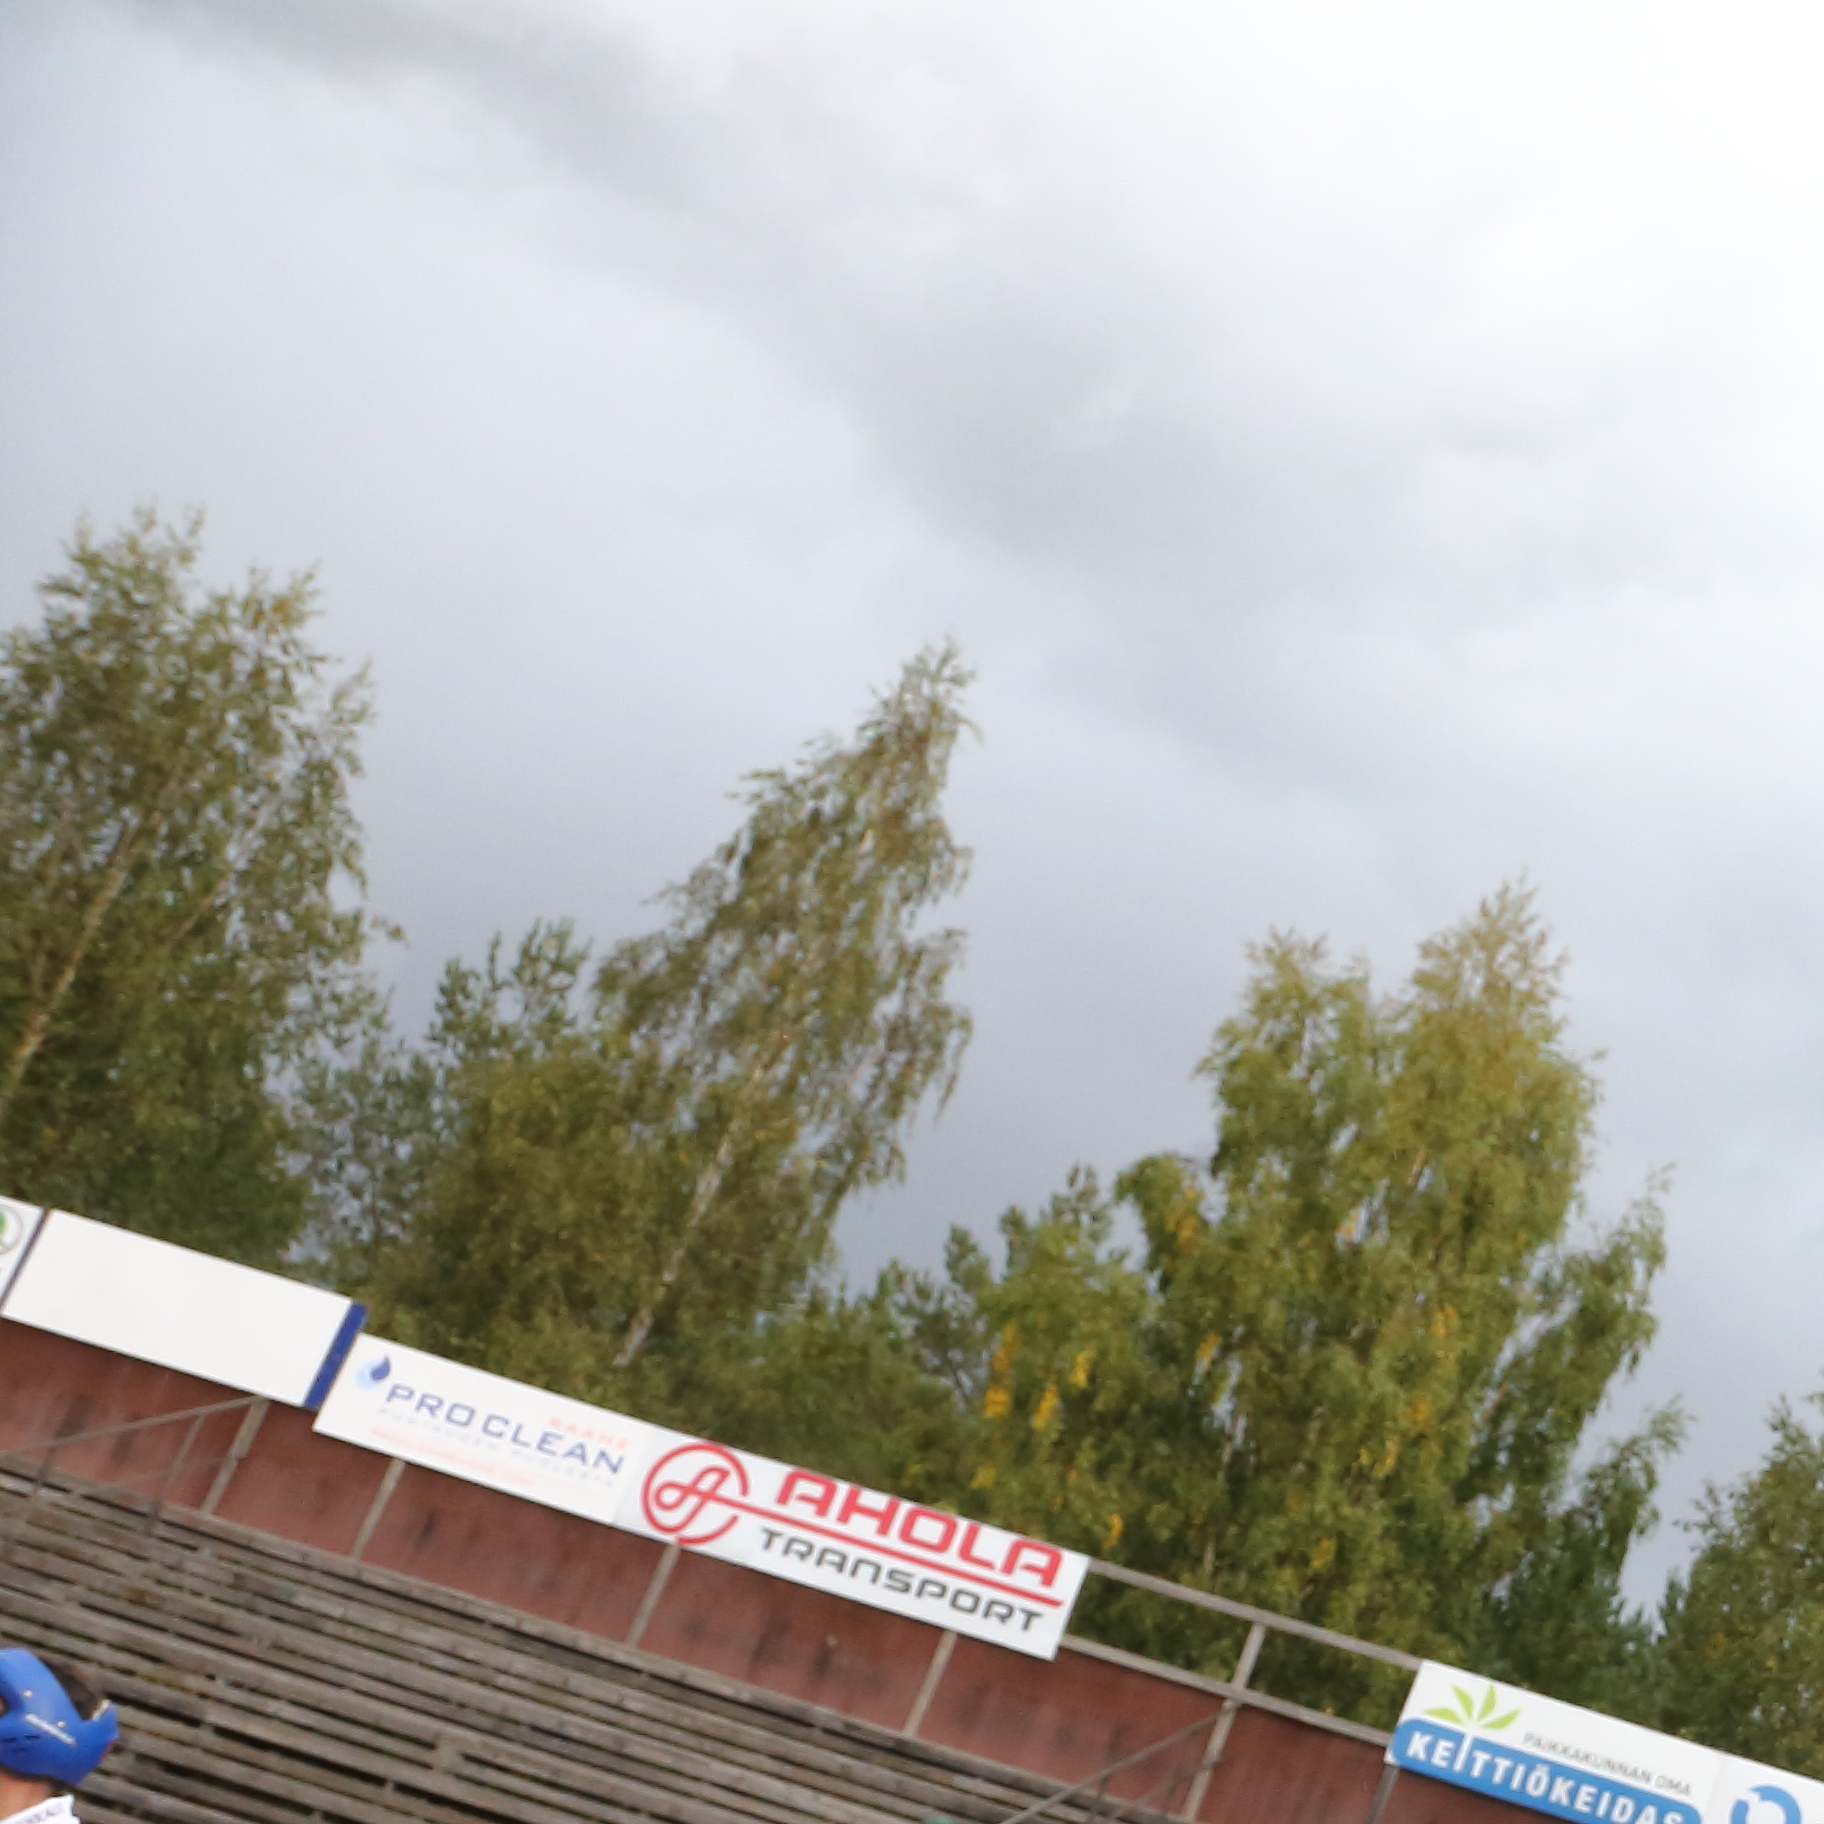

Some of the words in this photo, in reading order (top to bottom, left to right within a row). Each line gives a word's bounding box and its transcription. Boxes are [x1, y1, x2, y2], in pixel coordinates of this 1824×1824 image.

[760, 1527, 1043, 1632] TRANSPORT
[775, 1467, 1063, 1588] AHOLA
[1653, 1774, 1693, 1798] OMA
